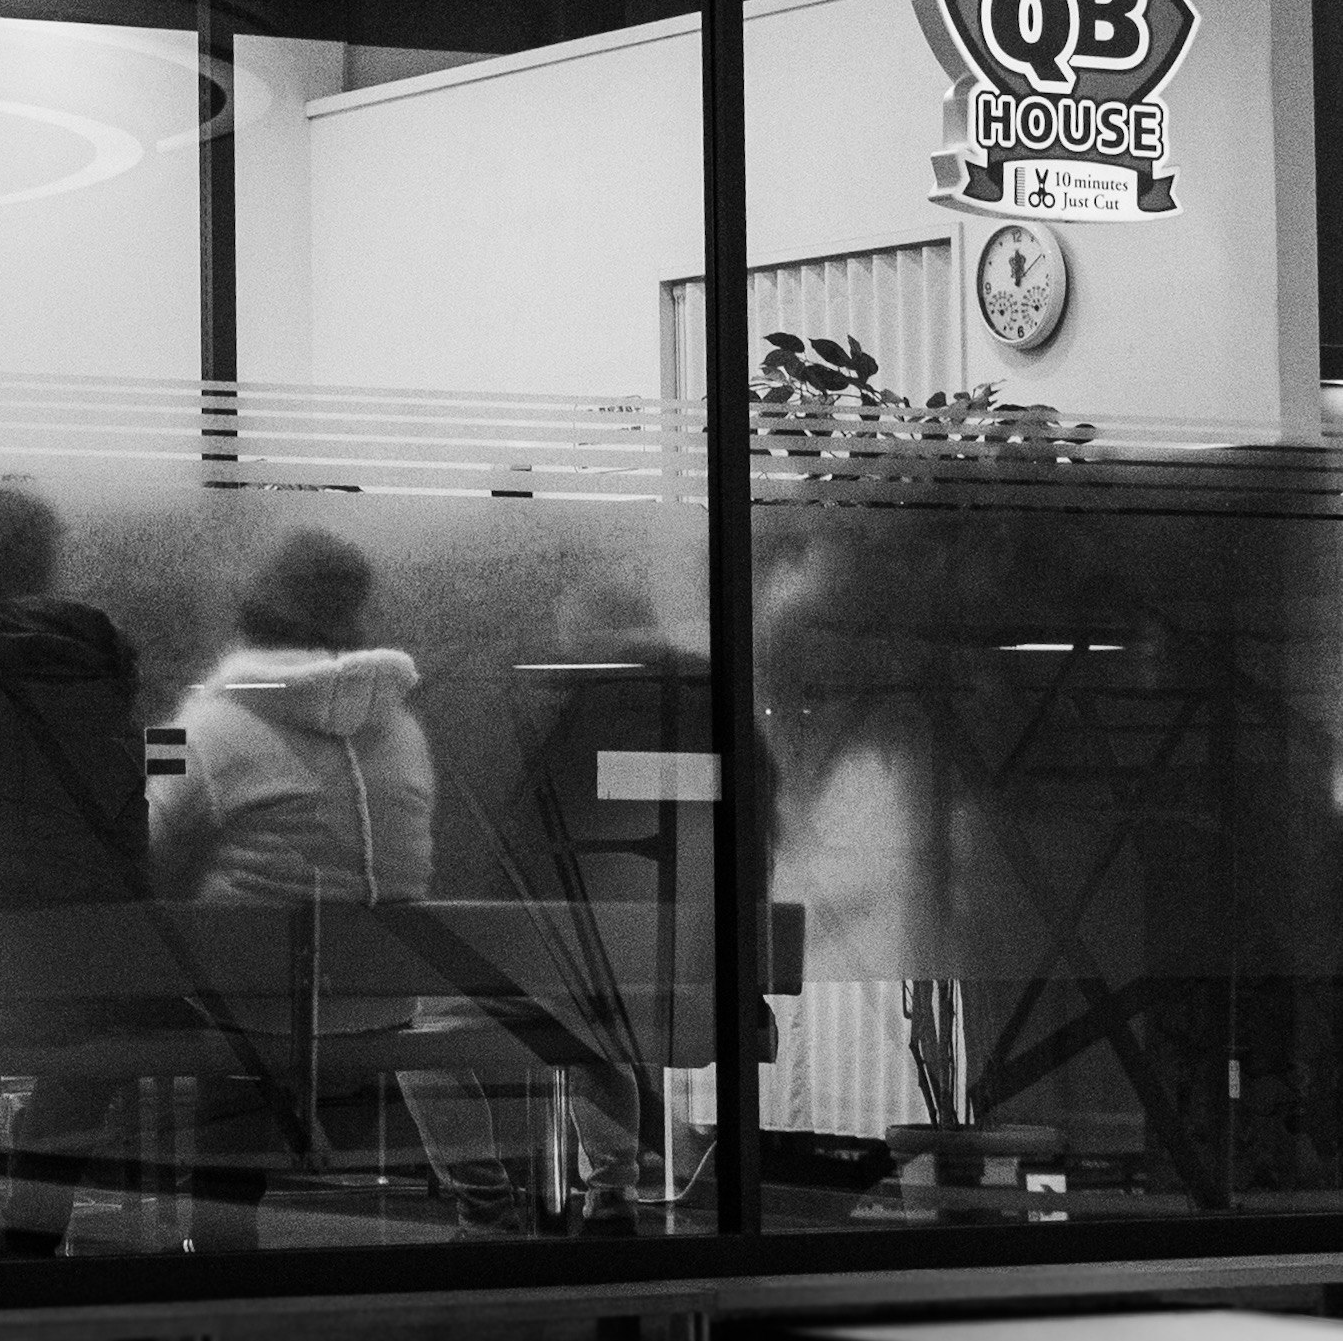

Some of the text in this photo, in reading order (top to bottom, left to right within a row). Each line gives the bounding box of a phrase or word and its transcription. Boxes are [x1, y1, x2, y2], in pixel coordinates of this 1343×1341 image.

[978, 94, 1163, 158] HOUSE
[1055, 171, 1129, 192] 10 minutes
[1061, 192, 1120, 211] Just Cut
[1012, 229, 1022, 243] 12
[984, 282, 992, 295] 9
[1017, 325, 1025, 339] 6
